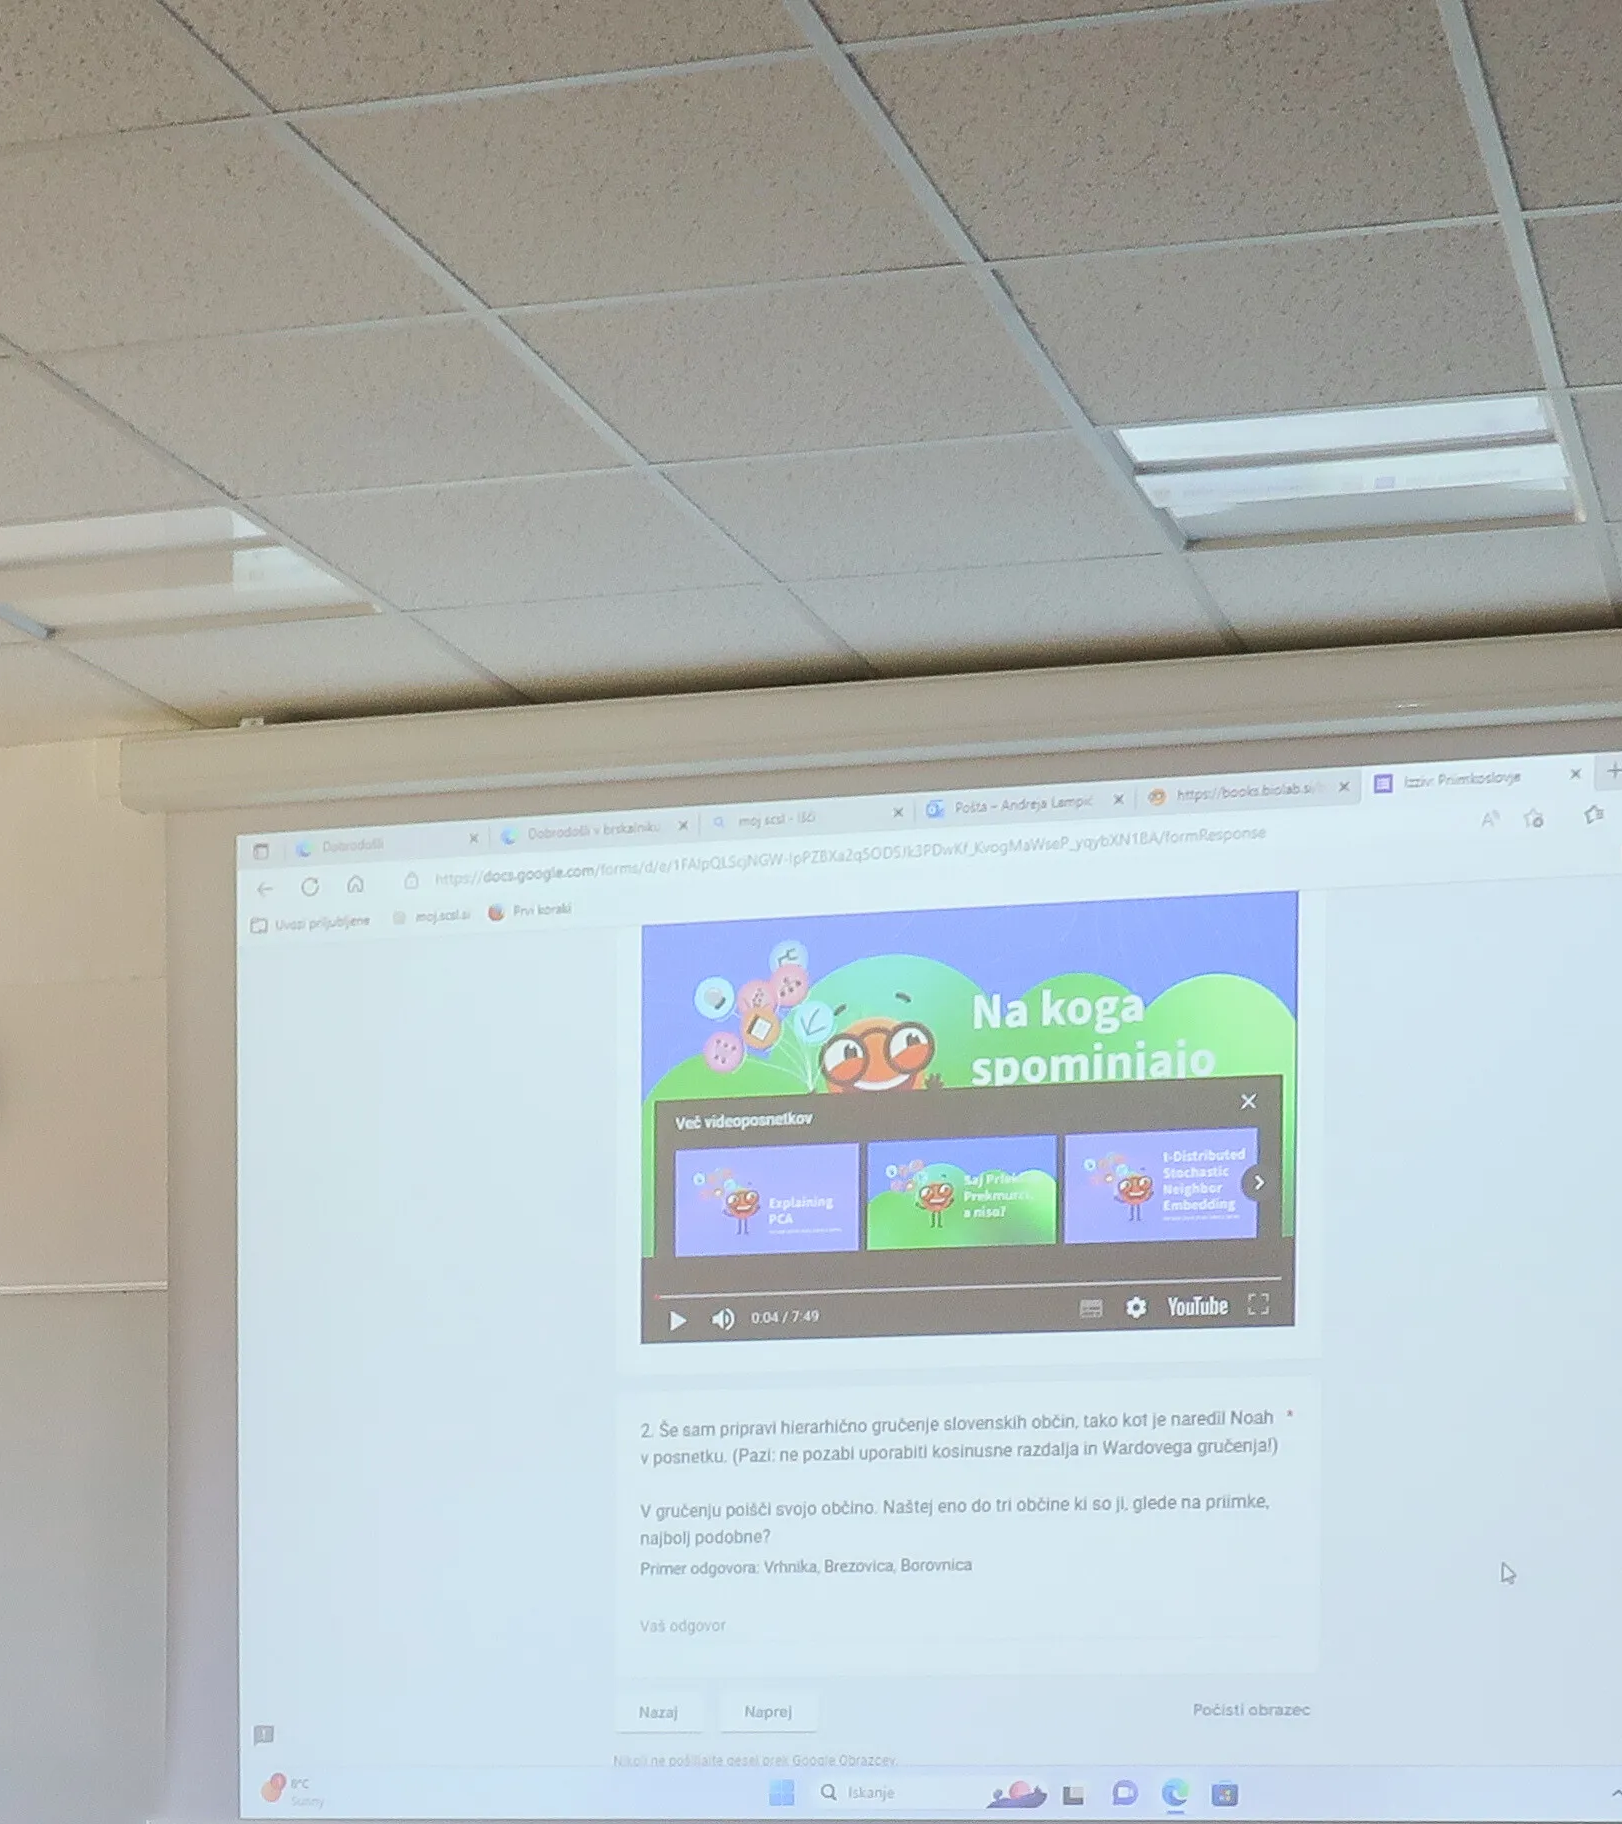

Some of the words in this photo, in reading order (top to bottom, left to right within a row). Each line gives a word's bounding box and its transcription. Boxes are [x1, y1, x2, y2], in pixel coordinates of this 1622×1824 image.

[972, 993, 1029, 1031] Na
[1040, 990, 1144, 1035] koga
[675, 1115, 702, 1131] Več
[704, 1111, 814, 1131] videoposnetkov
[1162, 1148, 1247, 1164] t-Distributed
[1162, 1165, 1230, 1179] Stochastic
[1162, 1182, 1223, 1197] Neighbor
[768, 1195, 835, 1212] Explaining
[1162, 1198, 1236, 1213] Embedding
[768, 1212, 794, 1226] PCA
[1167, 1296, 1229, 1317] YouTube
[751, 1309, 779, 1325] 0:04
[792, 1308, 820, 1324] 7:49
[640, 1422, 654, 1439] 2.
[659, 1419, 679, 1439] Še
[682, 1423, 716, 1438] sam
[719, 1420, 777, 1440] pripravi
[780, 1418, 868, 1436] hierarhično
[871, 1416, 939, 1437] gručenje
[943, 1413, 1027, 1432] slovenskih
[1030, 1412, 1079, 1431] občin,
[1083, 1412, 1118, 1429] tako
[1122, 1412, 1149, 1428] kot
[1150, 1412, 1167, 1431] je
[1170, 1410, 1227, 1428] naredil
[1230, 1409, 1274, 1426] Noah
[640, 1452, 650, 1465] v
[653, 1448, 728, 1469] posnetku.
[732, 1446, 777, 1468] (Pazi:
[779, 1448, 799, 1463] ne
[802, 1445, 854, 1466] pozabi
[859, 1443, 928, 1465] uporabiti
[931, 1442, 1013, 1459] kosinusne
[1016, 1440, 1079, 1460] razdalja
[1083, 1440, 1098, 1456] in
[1101, 1439, 1192, 1459] Wardovega
[1197, 1436, 1279, 1458] gručenja!)
[640, 1503, 652, 1519] V
[655, 1502, 721, 1522] gručenju
[725, 1500, 771, 1521] poišči
[775, 1501, 818, 1519] svojo
[821, 1499, 878, 1517] občino.
[882, 1497, 934, 1518] Naštej
[937, 1500, 967, 1515] eno
[971, 1497, 991, 1514] do
[995, 1496, 1012, 1513] tri
[1016, 1495, 1070, 1513] občine
[1073, 1495, 1087, 1512] ki
[1092, 1498, 1112, 1512] so
[1132, 1494, 1178, 1515] glede
[1180, 1497, 1201, 1512] na
[1205, 1493, 1271, 1515] priimke,
[640, 1530, 690, 1549] najbolj
[694, 1528, 771, 1549] podobne?
[640, 1561, 687, 1577] Primer
[690, 1560, 760, 1579] odgovora:
[764, 1559, 819, 1576] Vrhnika,
[823, 1558, 896, 1575] Brezovica,
[900, 1557, 973, 1573] Borovnica
[639, 1619, 666, 1633] Vaš
[669, 1619, 727, 1636] odgovor
[638, 1705, 679, 1722] Nazaj
[744, 1704, 793, 1721] Naprej
[1192, 1701, 1245, 1719] Počisti
[1248, 1701, 1311, 1719] obrazec
[847, 1785, 896, 1802] Iskanje
